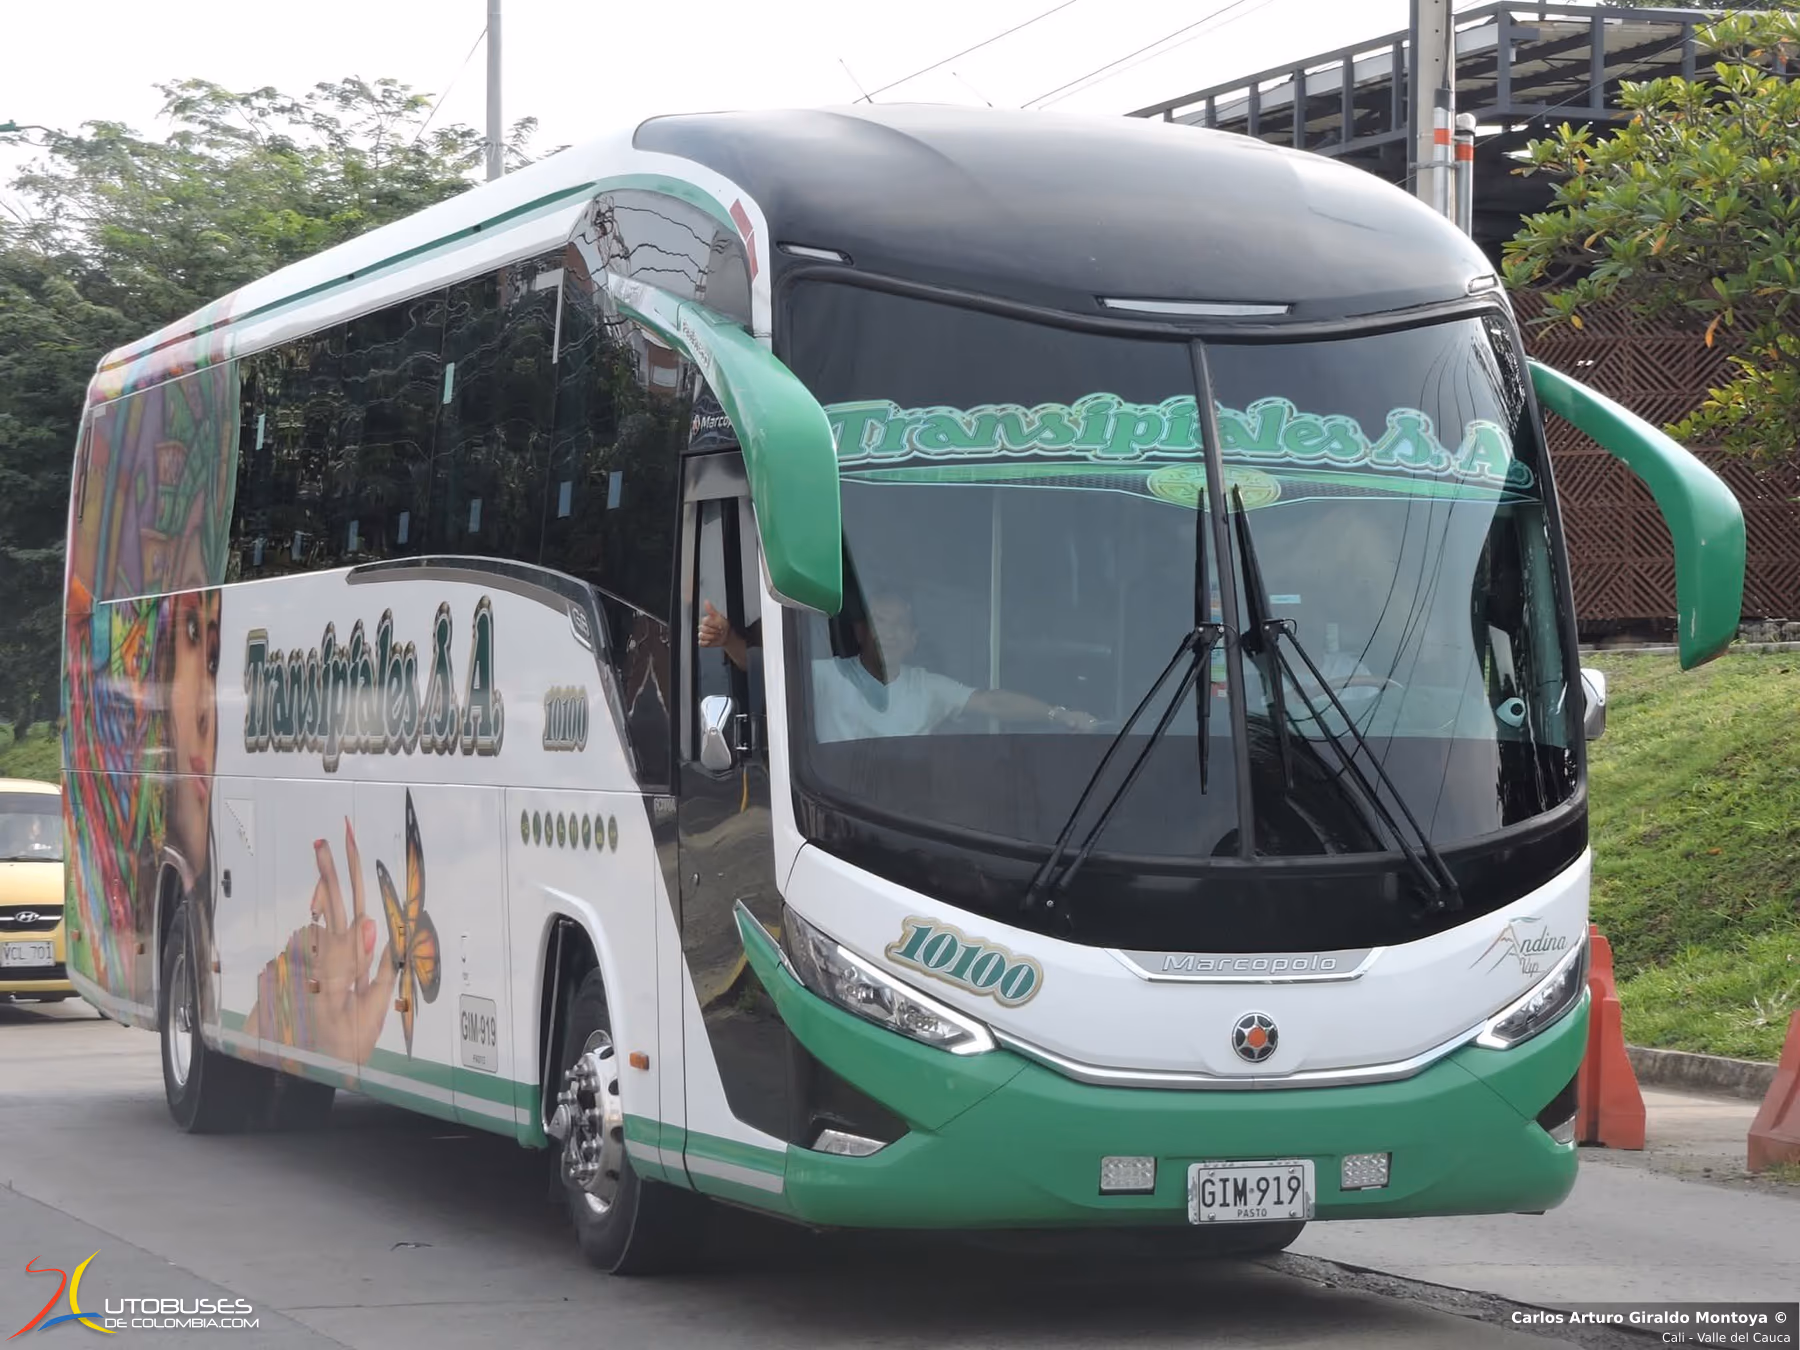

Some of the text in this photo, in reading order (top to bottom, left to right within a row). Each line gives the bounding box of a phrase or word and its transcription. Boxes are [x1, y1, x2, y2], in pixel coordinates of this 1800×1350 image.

[542, 685, 588, 752] 10100
[884, 914, 1044, 1008] 10100
[1161, 954, 1337, 975] Marcopolo
[1237, 1208, 1267, 1217] PASTO
